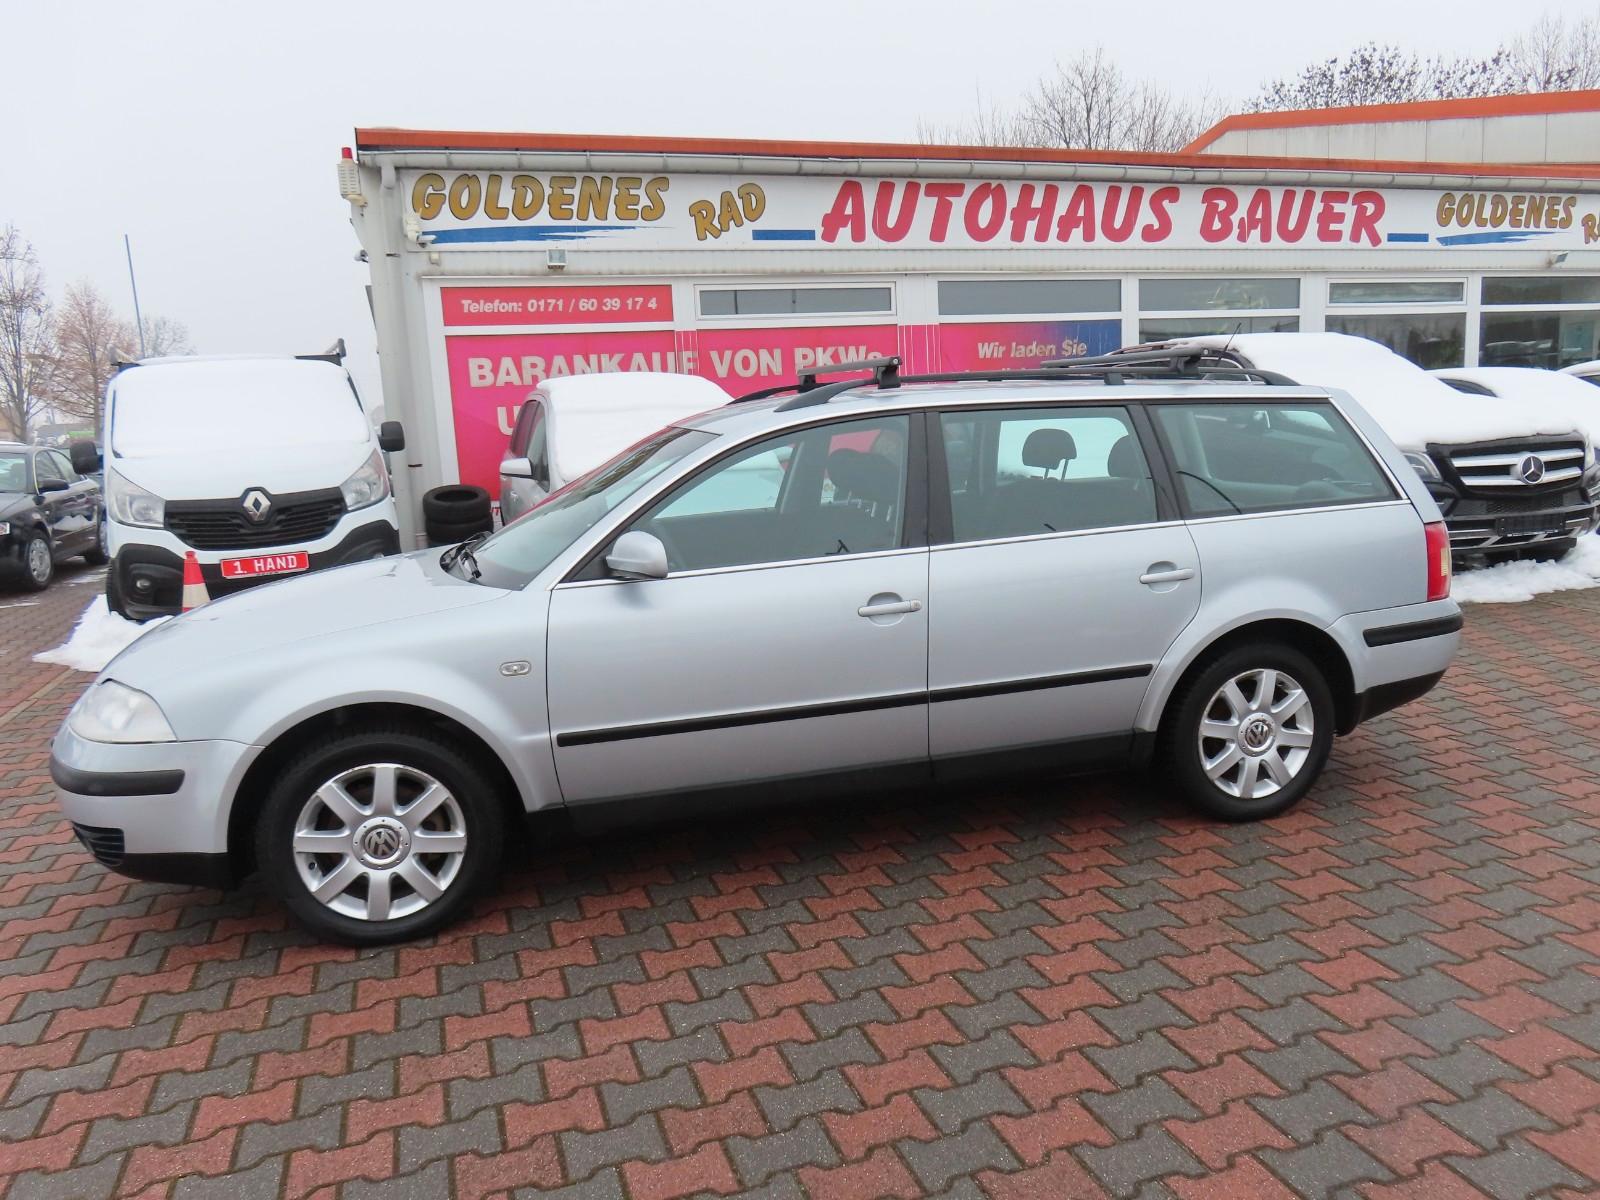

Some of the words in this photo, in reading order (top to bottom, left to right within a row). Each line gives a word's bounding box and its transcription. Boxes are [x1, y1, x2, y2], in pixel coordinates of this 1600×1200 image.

[411, 173, 669, 221] GOLDENES
[689, 182, 766, 242] RAD
[821, 180, 1180, 244] AUTOHAUS
[1199, 186, 1386, 248] BAUER
[1436, 192, 1577, 230] GOLDENES
[1581, 213, 1600, 245] R
[461, 299, 523, 313] Telefon:
[527, 299, 564, 312] 0171
[578, 298, 598, 312] 60
[602, 298, 621, 311] 39
[977, 341, 1006, 359] Wir
[1010, 340, 1056, 358] laden
[1061, 337, 1088, 356] Sie
[467, 350, 698, 388] BARANKAUF
[709, 348, 783, 378] VON
[233, 561, 247, 574] 1.
[253, 556, 297, 572] HAND
